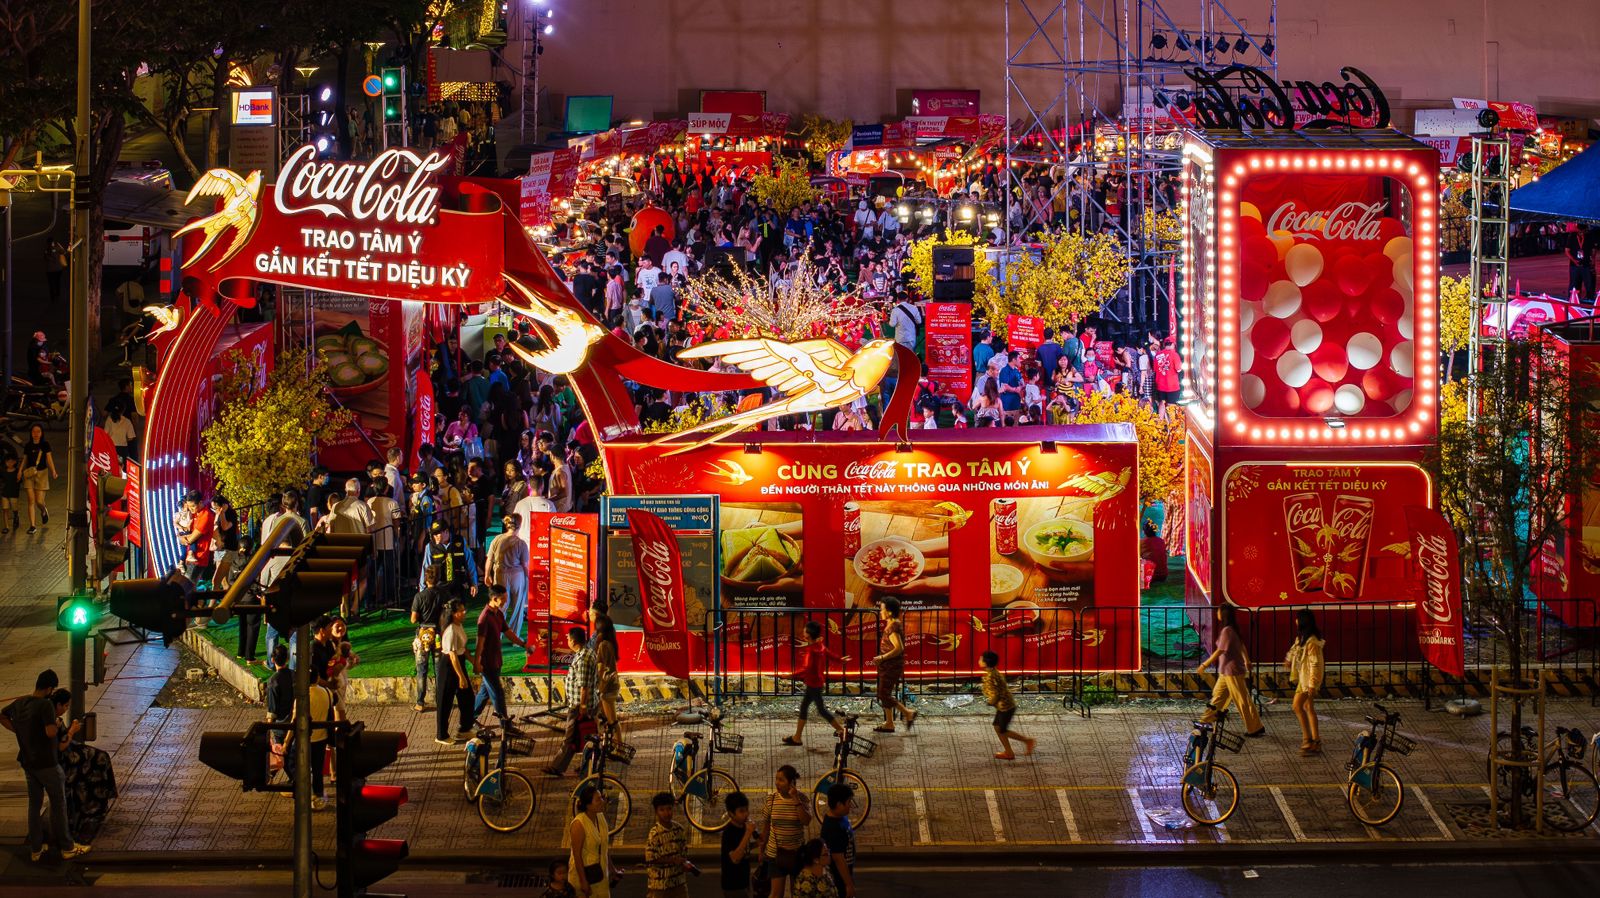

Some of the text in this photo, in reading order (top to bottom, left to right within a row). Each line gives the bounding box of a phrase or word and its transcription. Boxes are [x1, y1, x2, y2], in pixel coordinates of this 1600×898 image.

[1422, 140, 1450, 150] URGER
[274, 145, 450, 225] Coca-Cola
[1266, 201, 1389, 240] Coca-Cola
[301, 228, 422, 254] TRAO TÂM Ý
[256, 246, 470, 289] GẮN KẾT TẾT DIỆU KỲ
[777, 456, 1032, 480] CÙNG Coca-Cola TRAO TÂM Ý
[1293, 467, 1361, 478] TRAO TÂM Ý
[761, 483, 783, 495] ĐẾN
[786, 484, 820, 495] NGƯỜI
[822, 483, 851, 494] THÂN
[854, 482, 872, 493] TẾT
[875, 483, 896, 493] NÀY
[898, 481, 935, 492] THÔNG
[938, 483, 960, 492] QUA
[963, 480, 1001, 491] NHỮNG
[1004, 479, 1029, 490] MÓN
[1267, 478, 1387, 492] GẮN KẾT TẾT DIỆU KỲ
[550, 515, 576, 526] Coca-Cola
[1288, 503, 1374, 540] Coca Cola
[638, 536, 676, 628] Coca-Cola
[1417, 531, 1451, 622] Coca-Cola
[646, 642, 680, 651] FOODMARKS
[1419, 636, 1456, 645] FOODMARKS
